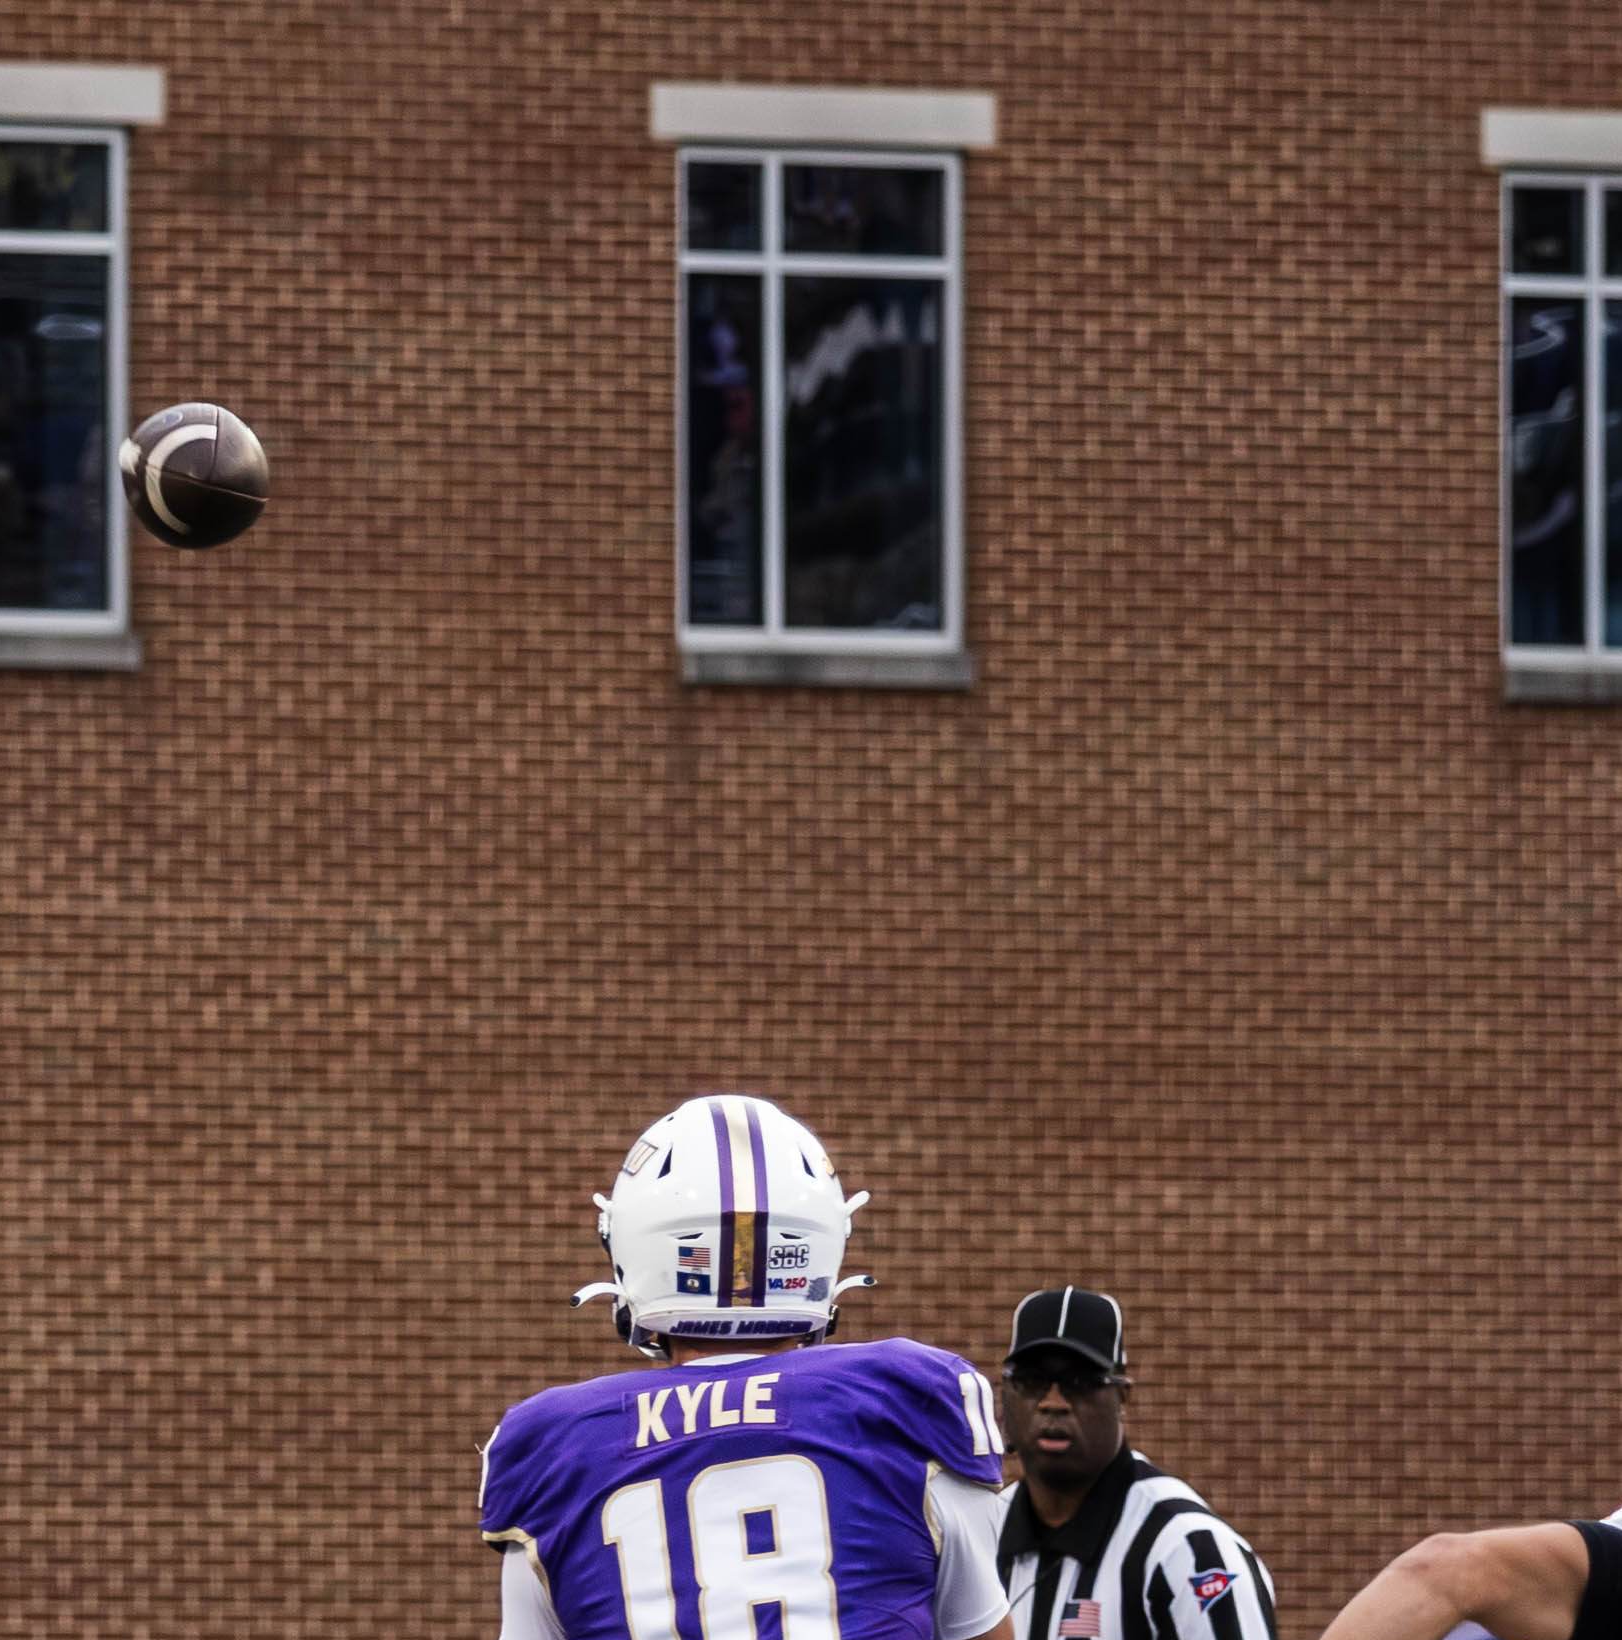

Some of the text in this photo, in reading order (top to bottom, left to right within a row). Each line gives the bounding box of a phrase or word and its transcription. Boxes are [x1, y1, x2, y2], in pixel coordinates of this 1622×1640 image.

[768, 1243, 810, 1270] SBC
[669, 1320, 733, 1335] JAMES
[636, 1372, 782, 1448] KYLE
